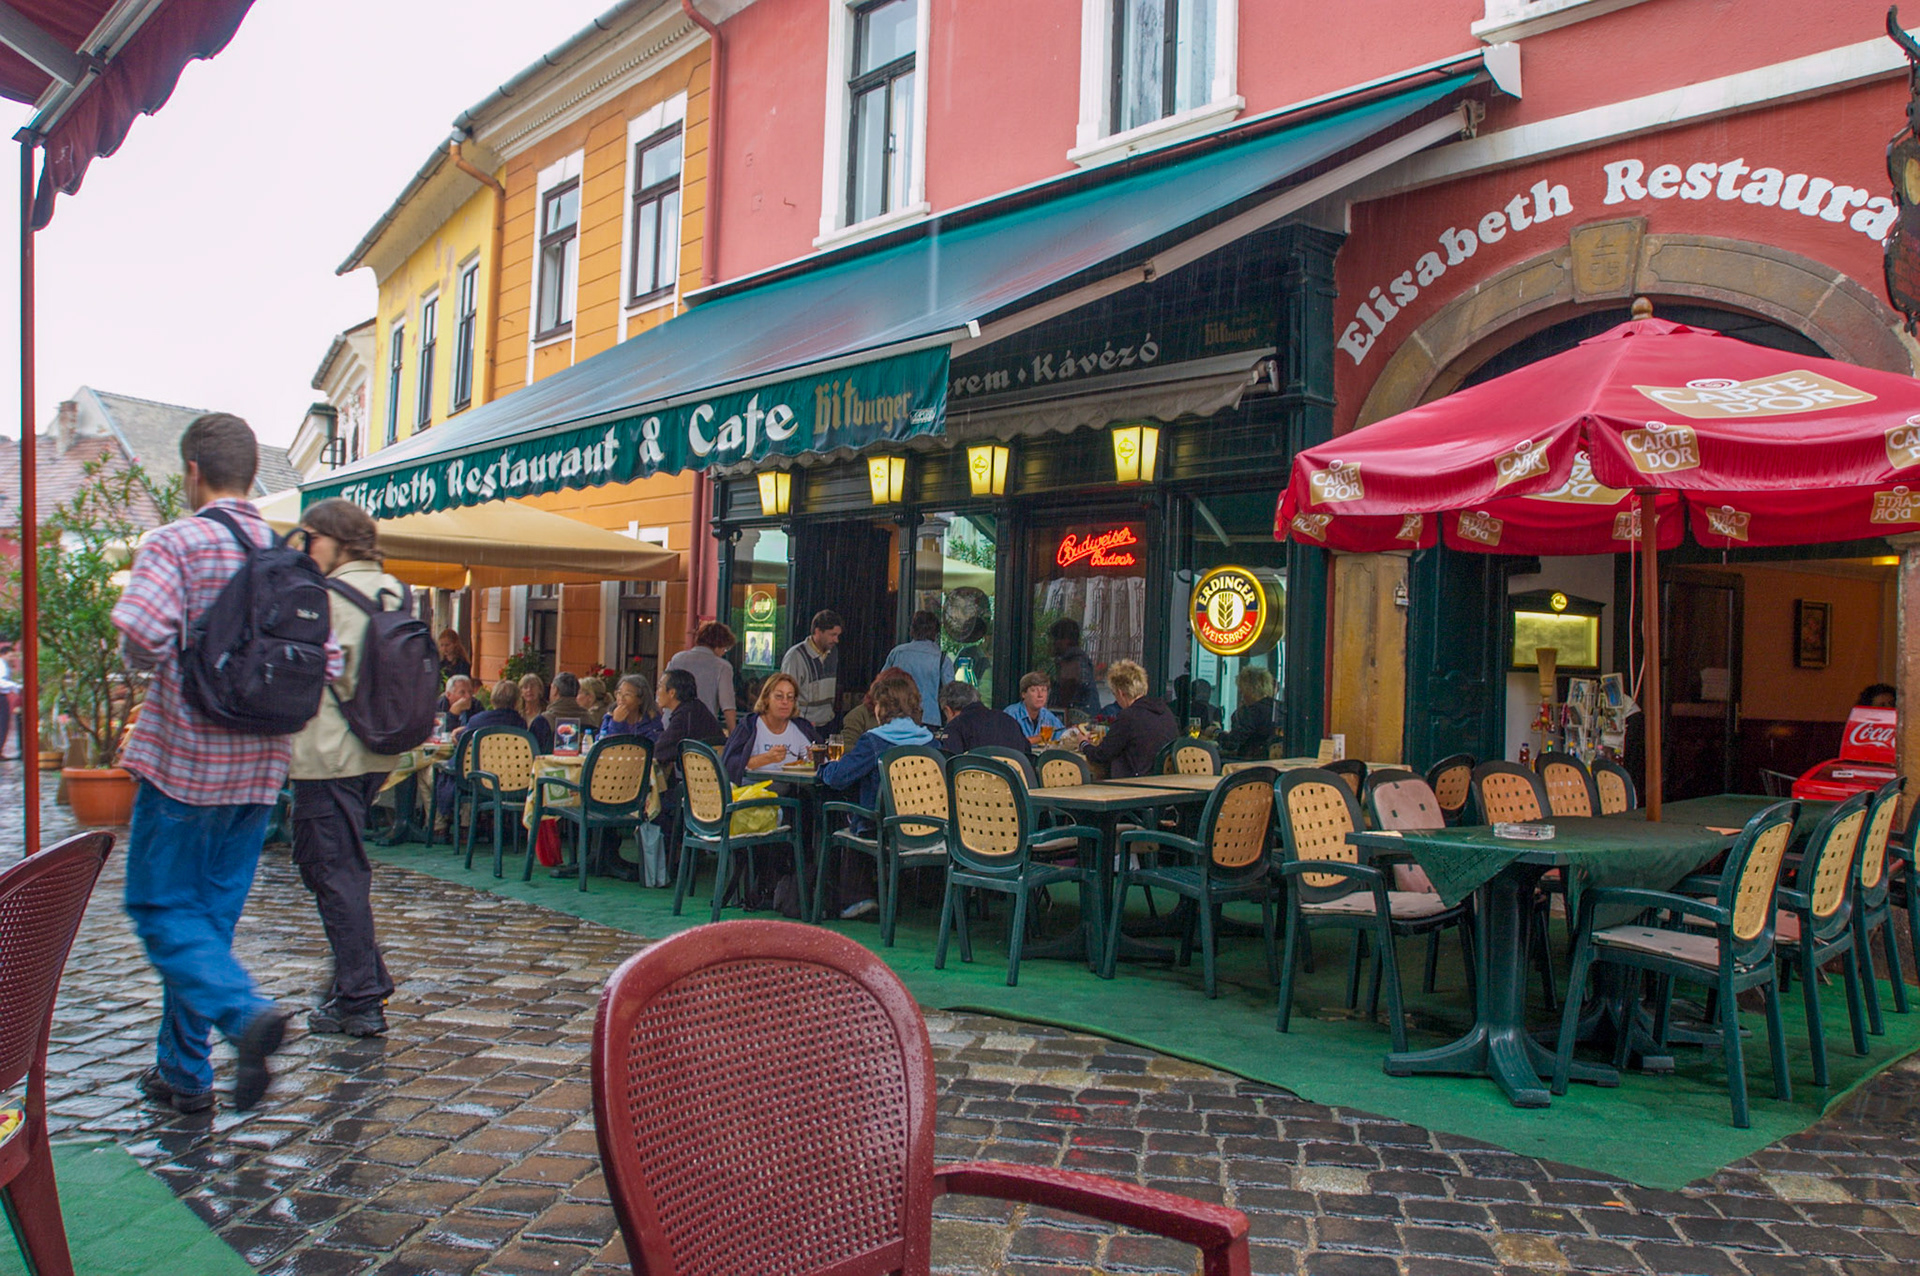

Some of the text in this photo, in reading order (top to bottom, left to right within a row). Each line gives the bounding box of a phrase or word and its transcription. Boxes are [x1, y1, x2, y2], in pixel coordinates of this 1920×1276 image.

[1337, 178, 1574, 366] Elisabeth
[1031, 333, 1159, 383] Kávézó
[1650, 377, 1819, 404] CARTE
[1714, 388, 1864, 414] D'OR
[814, 377, 912, 435] Bitburger
[446, 425, 620, 498] Restaurant
[639, 416, 665, 464] &
[688, 393, 799, 458] Cafe
[1626, 429, 1691, 452] CARTE
[1646, 448, 1697, 468] D'OR
[1312, 467, 1356, 487] CARTE
[1323, 482, 1362, 499] D'OR
[1057, 526, 1137, 567] Budweiser
[1198, 575, 1256, 606] ERDINGER
[1849, 720, 1893, 749] Coca
